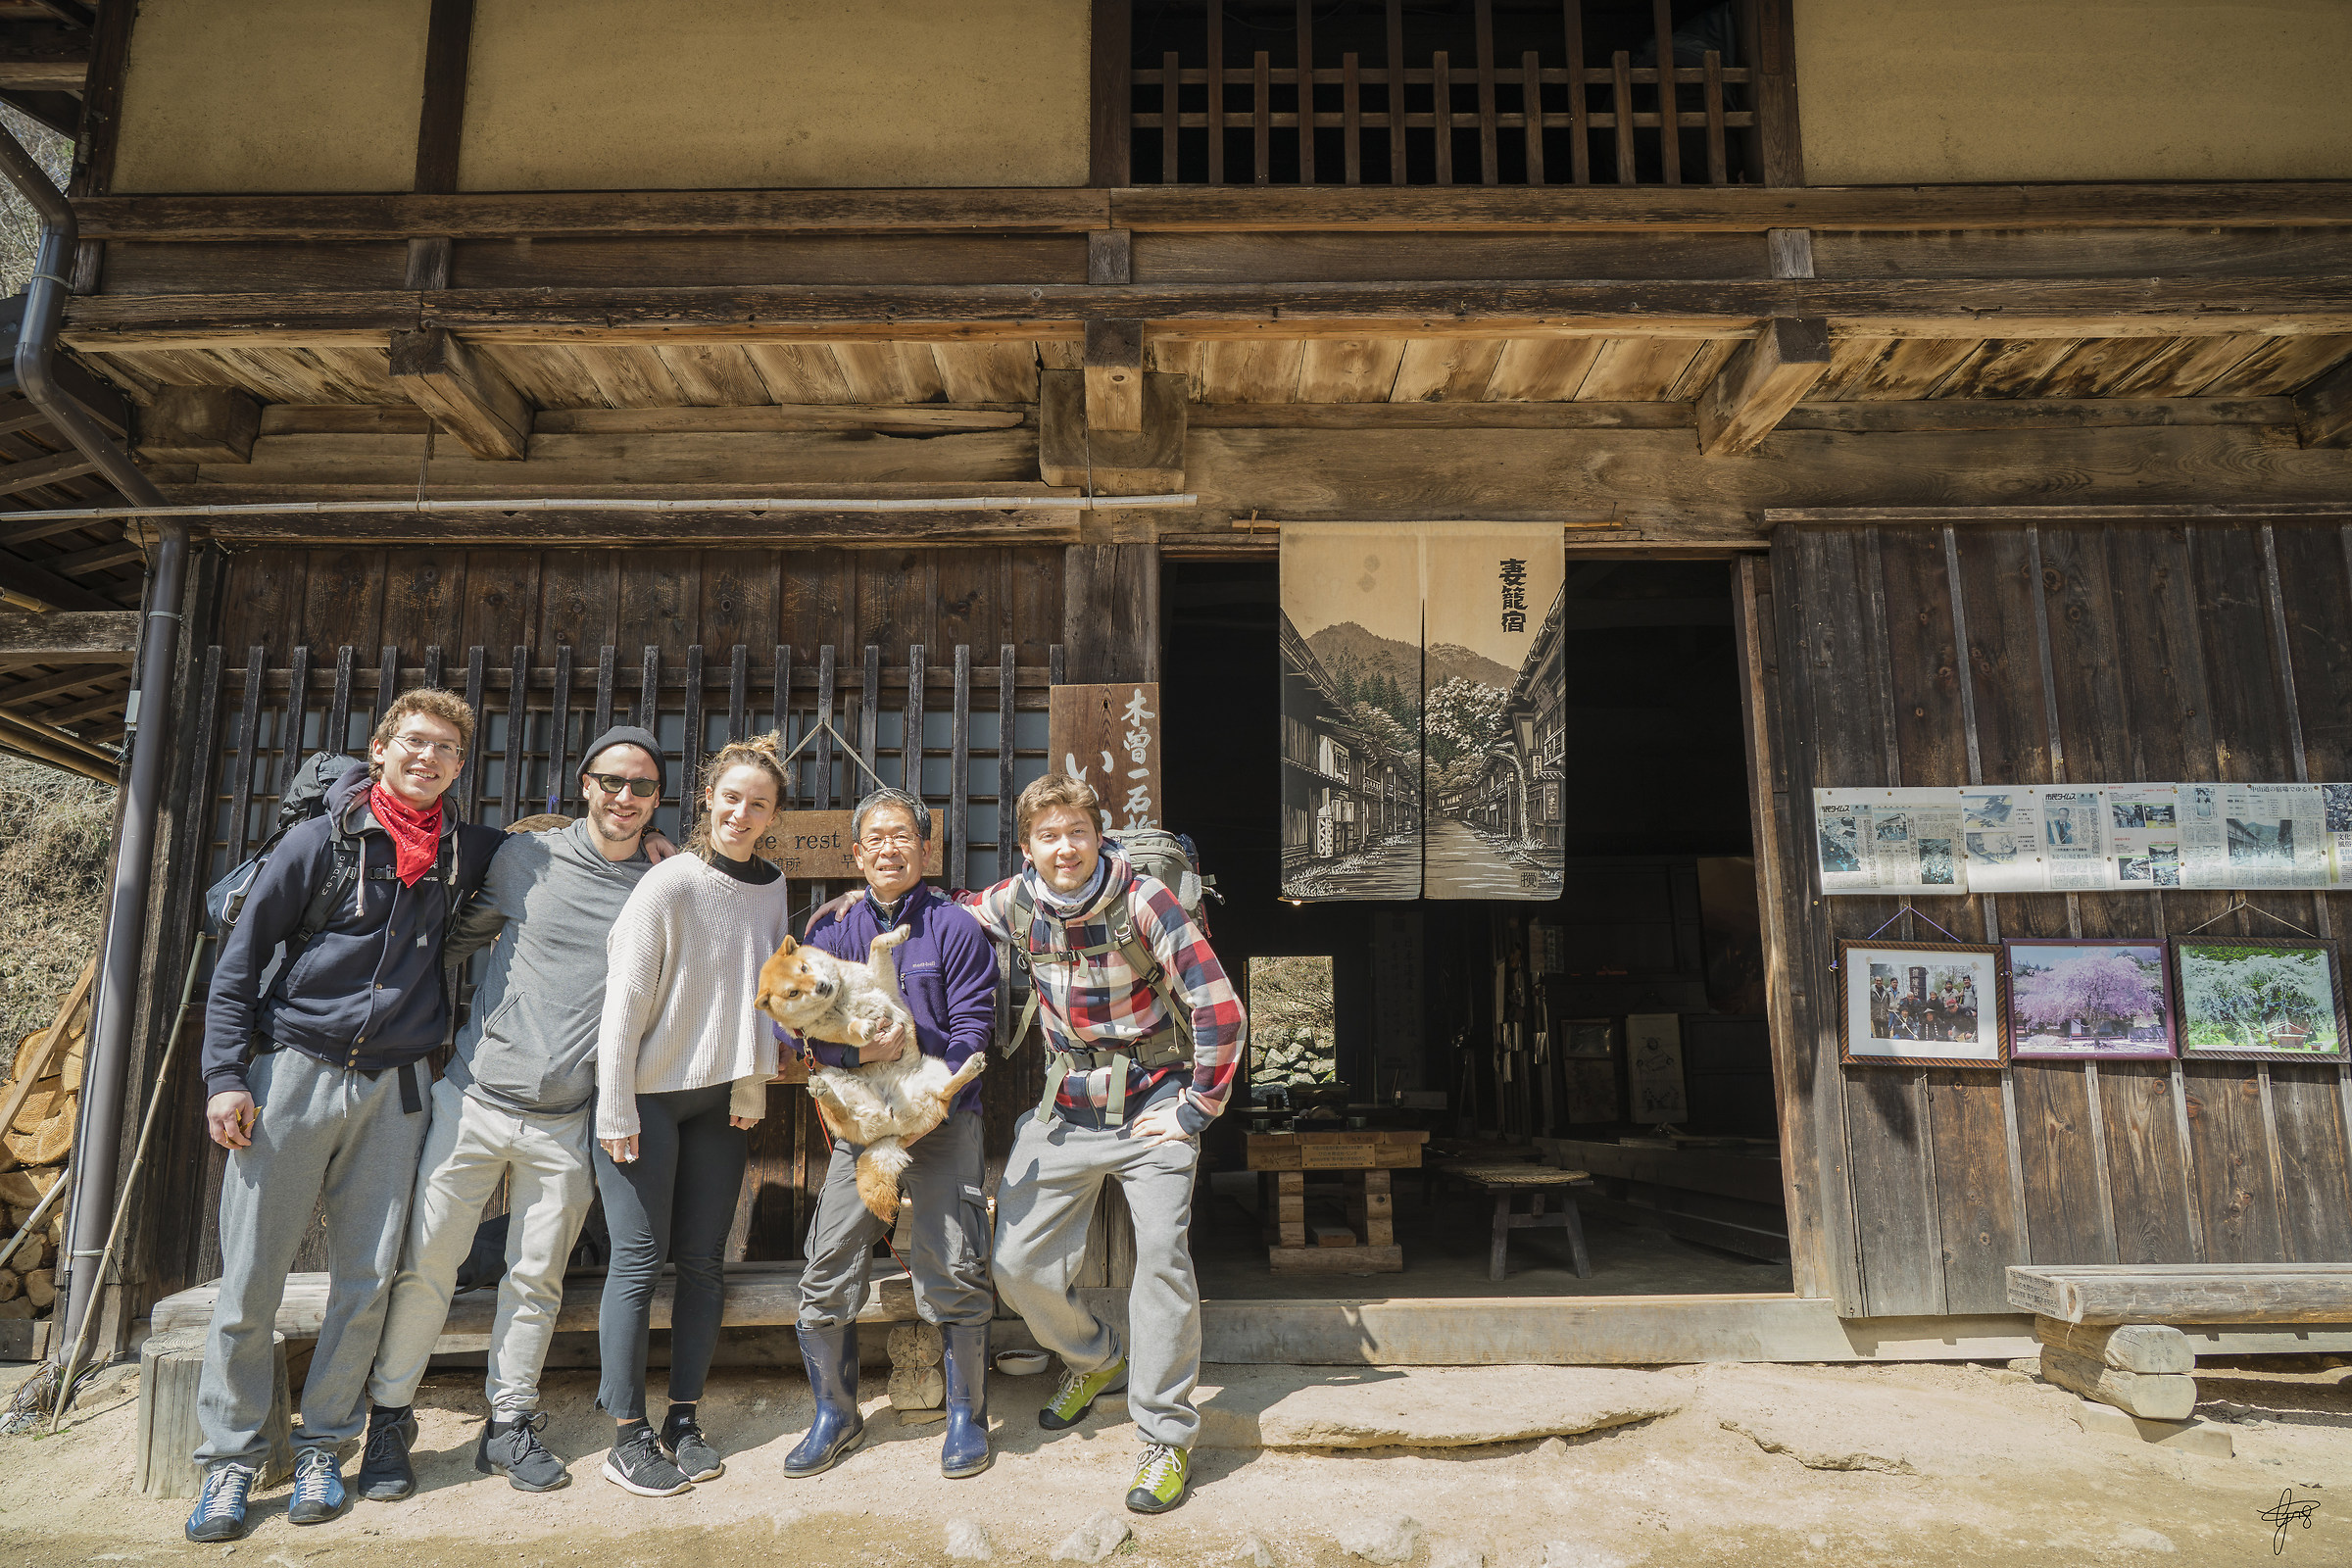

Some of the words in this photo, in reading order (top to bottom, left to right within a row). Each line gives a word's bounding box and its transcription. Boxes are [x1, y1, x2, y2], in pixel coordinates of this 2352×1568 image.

[1498, 558, 1528, 633] 妻籠宿
[754, 835, 777, 850] ee
[794, 830, 841, 850] rest
[321, 855, 346, 896] osprey
[841, 854, 856, 869] 무
